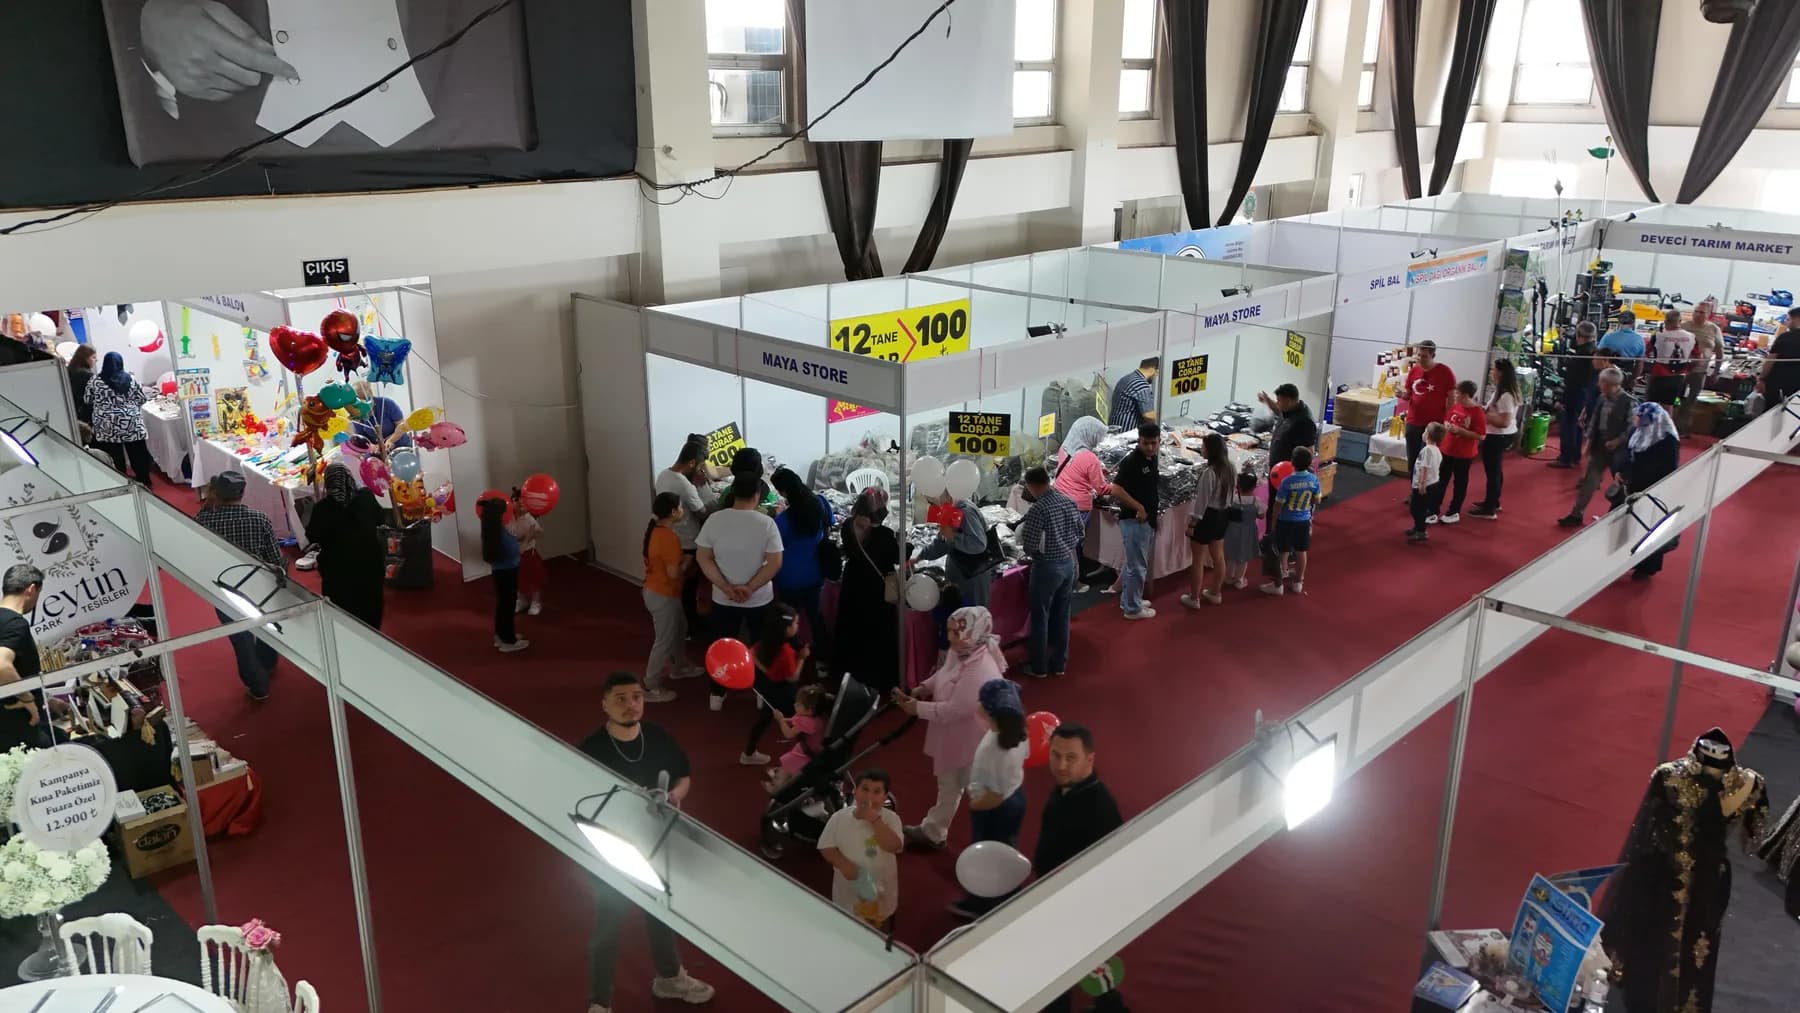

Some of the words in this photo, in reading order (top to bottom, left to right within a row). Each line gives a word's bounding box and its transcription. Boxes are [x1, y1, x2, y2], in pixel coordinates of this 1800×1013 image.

[1640, 234, 1687, 246] DEVECİ
[1691, 238, 1731, 249] TARIM
[1735, 241, 1793, 255] MARKET
[306, 261, 345, 276] ÇIKIŞ
[1387, 275, 1401, 286] BAL
[1204, 312, 1230, 328] MAYA
[1232, 305, 1261, 322] STORE
[835, 323, 871, 355] 12
[871, 332, 898, 345] TANE
[915, 308, 967, 347] 100
[1186, 358, 1204, 367] TANE
[1287, 350, 1300, 367] 100
[762, 352, 798, 373] MAYA
[802, 361, 848, 385] STORE
[1175, 377, 1200, 395] 100
[958, 414, 970, 424] 12
[972, 415, 1002, 425] TANE
[712, 426, 733, 440] TANE
[954, 437, 998, 454] 100
[1288, 490, 1313, 511] 10
[34, 618, 63, 636] PARK
[40, 767, 90, 788] Kampanya
[46, 802, 73, 815] Fuara
[46, 811, 88, 832] 12.900
